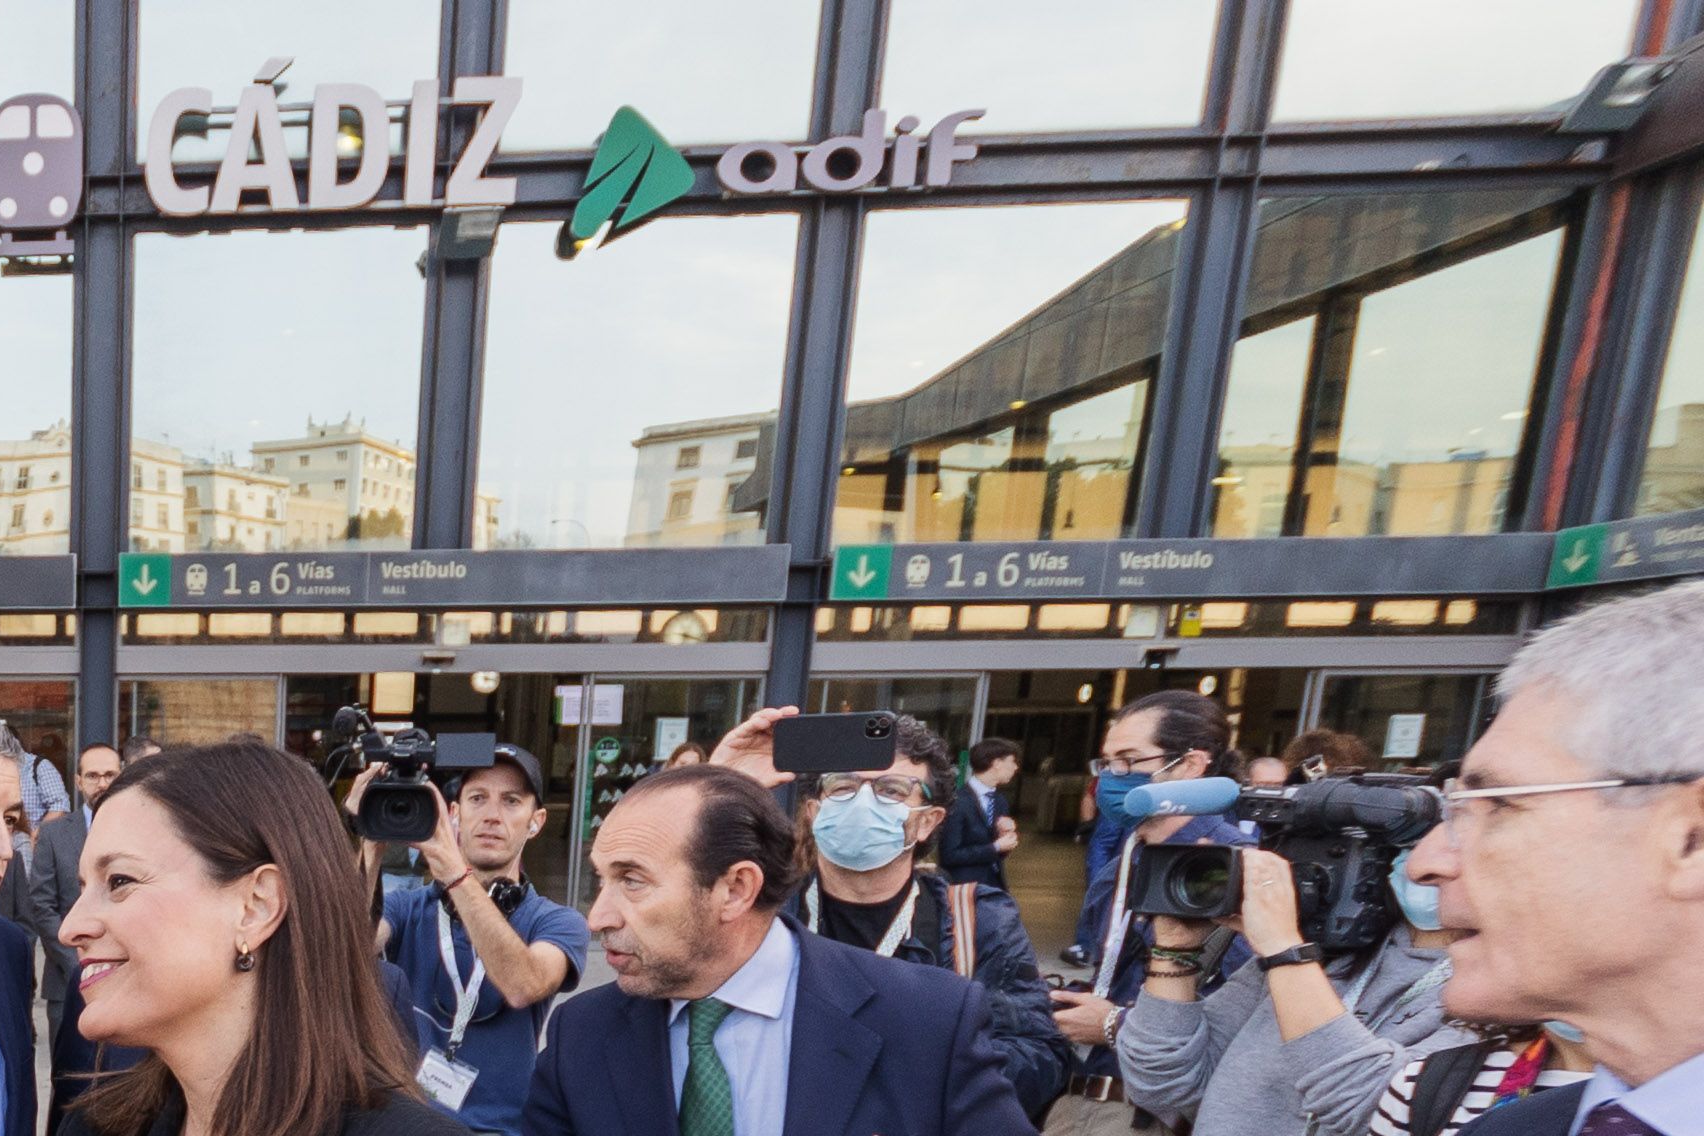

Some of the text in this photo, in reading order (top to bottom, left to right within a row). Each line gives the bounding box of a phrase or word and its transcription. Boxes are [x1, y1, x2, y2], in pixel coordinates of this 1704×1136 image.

[145, 57, 524, 217] CÁDIZ
[717, 107, 987, 194] adif
[381, 559, 467, 579] Vestíbulo
[944, 550, 1070, 588] 1 a 6 Vías
[1118, 548, 1214, 570] Vestíbulo
[223, 560, 335, 595] 1 a 6 Vías
[1024, 576, 1086, 588] PLATFORMS
[1118, 575, 1146, 587] HALL
[296, 585, 352, 596] PLATFORMS
[382, 585, 407, 595] HALL
